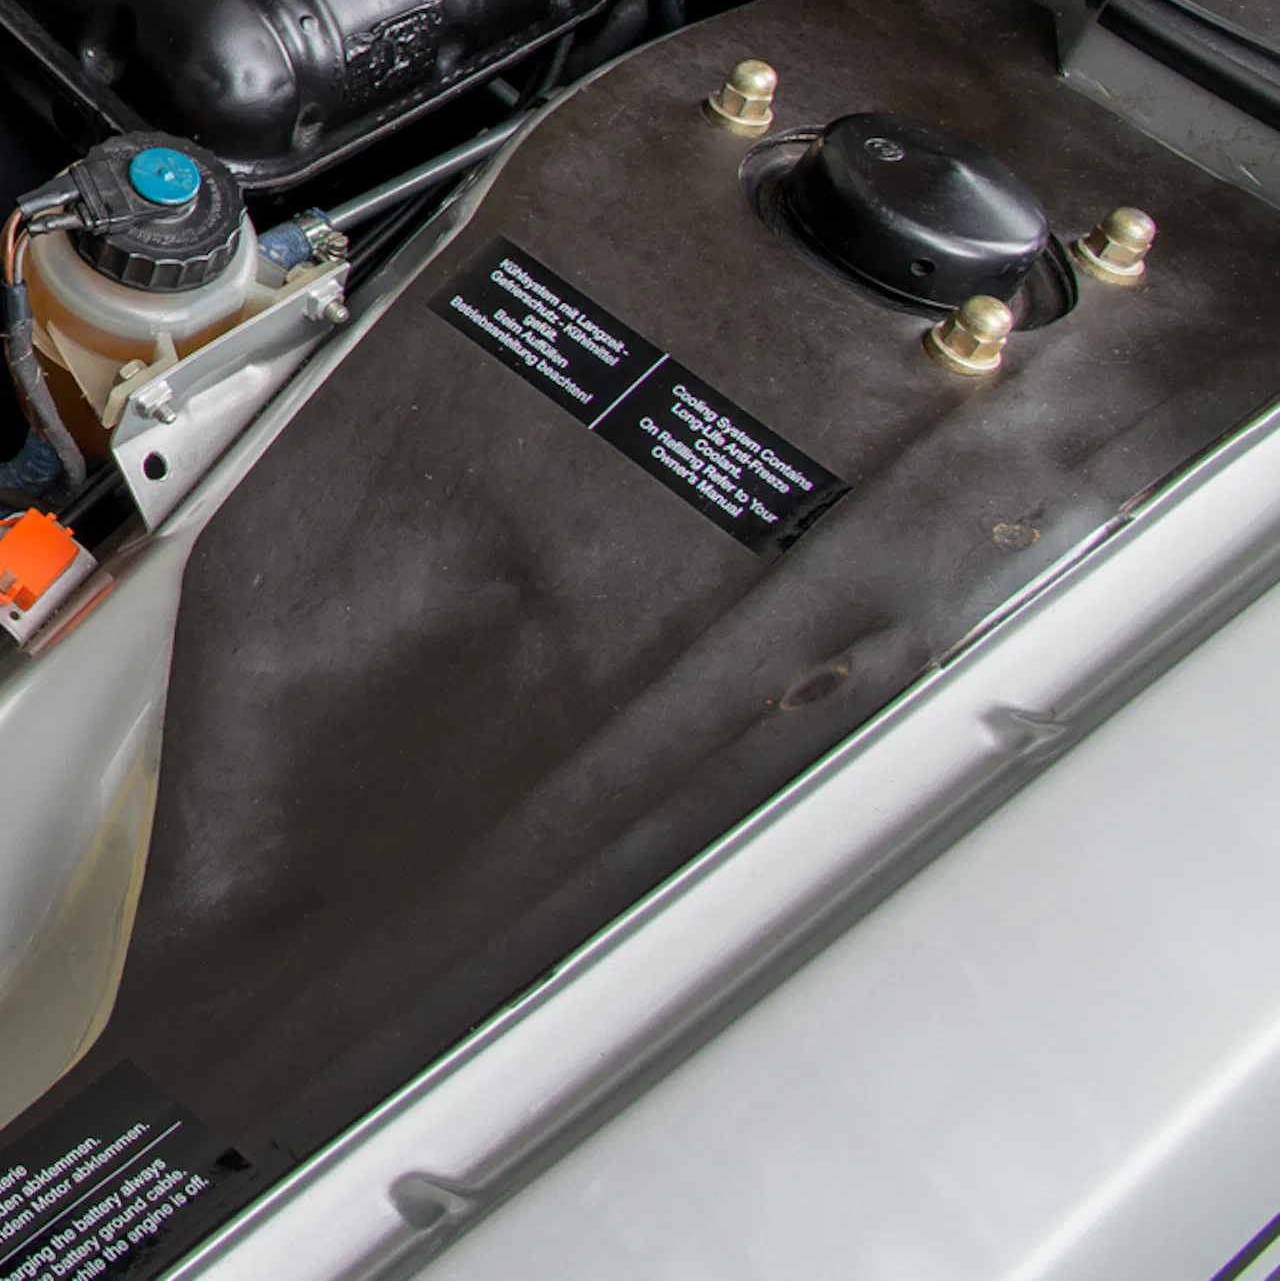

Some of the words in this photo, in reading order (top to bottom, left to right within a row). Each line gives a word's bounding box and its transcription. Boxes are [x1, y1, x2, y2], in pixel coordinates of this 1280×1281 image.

[490, 269, 560, 324] Gefrierschutz
[562, 322, 620, 367] Kühlmittel
[493, 308, 523, 335] Beim
[497, 258, 561, 307] Kühlsystem
[557, 302, 580, 325] mit
[574, 313, 625, 353] Langzeit
[535, 358, 594, 404] beachten!
[639, 417, 660, 436] On
[701, 463, 737, 493] Refer
[733, 488, 750, 503] to
[749, 497, 778, 523] Your
[651, 445, 699, 485] Owner's
[695, 479, 744, 518] Manual
[672, 384, 719, 423] Cooling
[716, 416, 761, 454] System
[760, 448, 813, 491] Contains
[694, 438, 742, 480] Coolant.
[21, 1137, 102, 1198] abklemmen.
[30, 1178, 73, 1213] Motor
[71, 1123, 151, 1183] abklemmen.
[50, 1228, 77, 1250] the
[71, 1191, 123, 1233] battery
[119, 1158, 167, 1198] always
[50, 1235, 100, 1277] battery
[98, 1196, 148, 1241] ground
[146, 1170, 188, 1202] cable.
[97, 1236, 129, 1262] the
[127, 1203, 174, 1244] engine
[168, 1192, 188, 1208] is
[184, 1174, 210, 1196] off.
